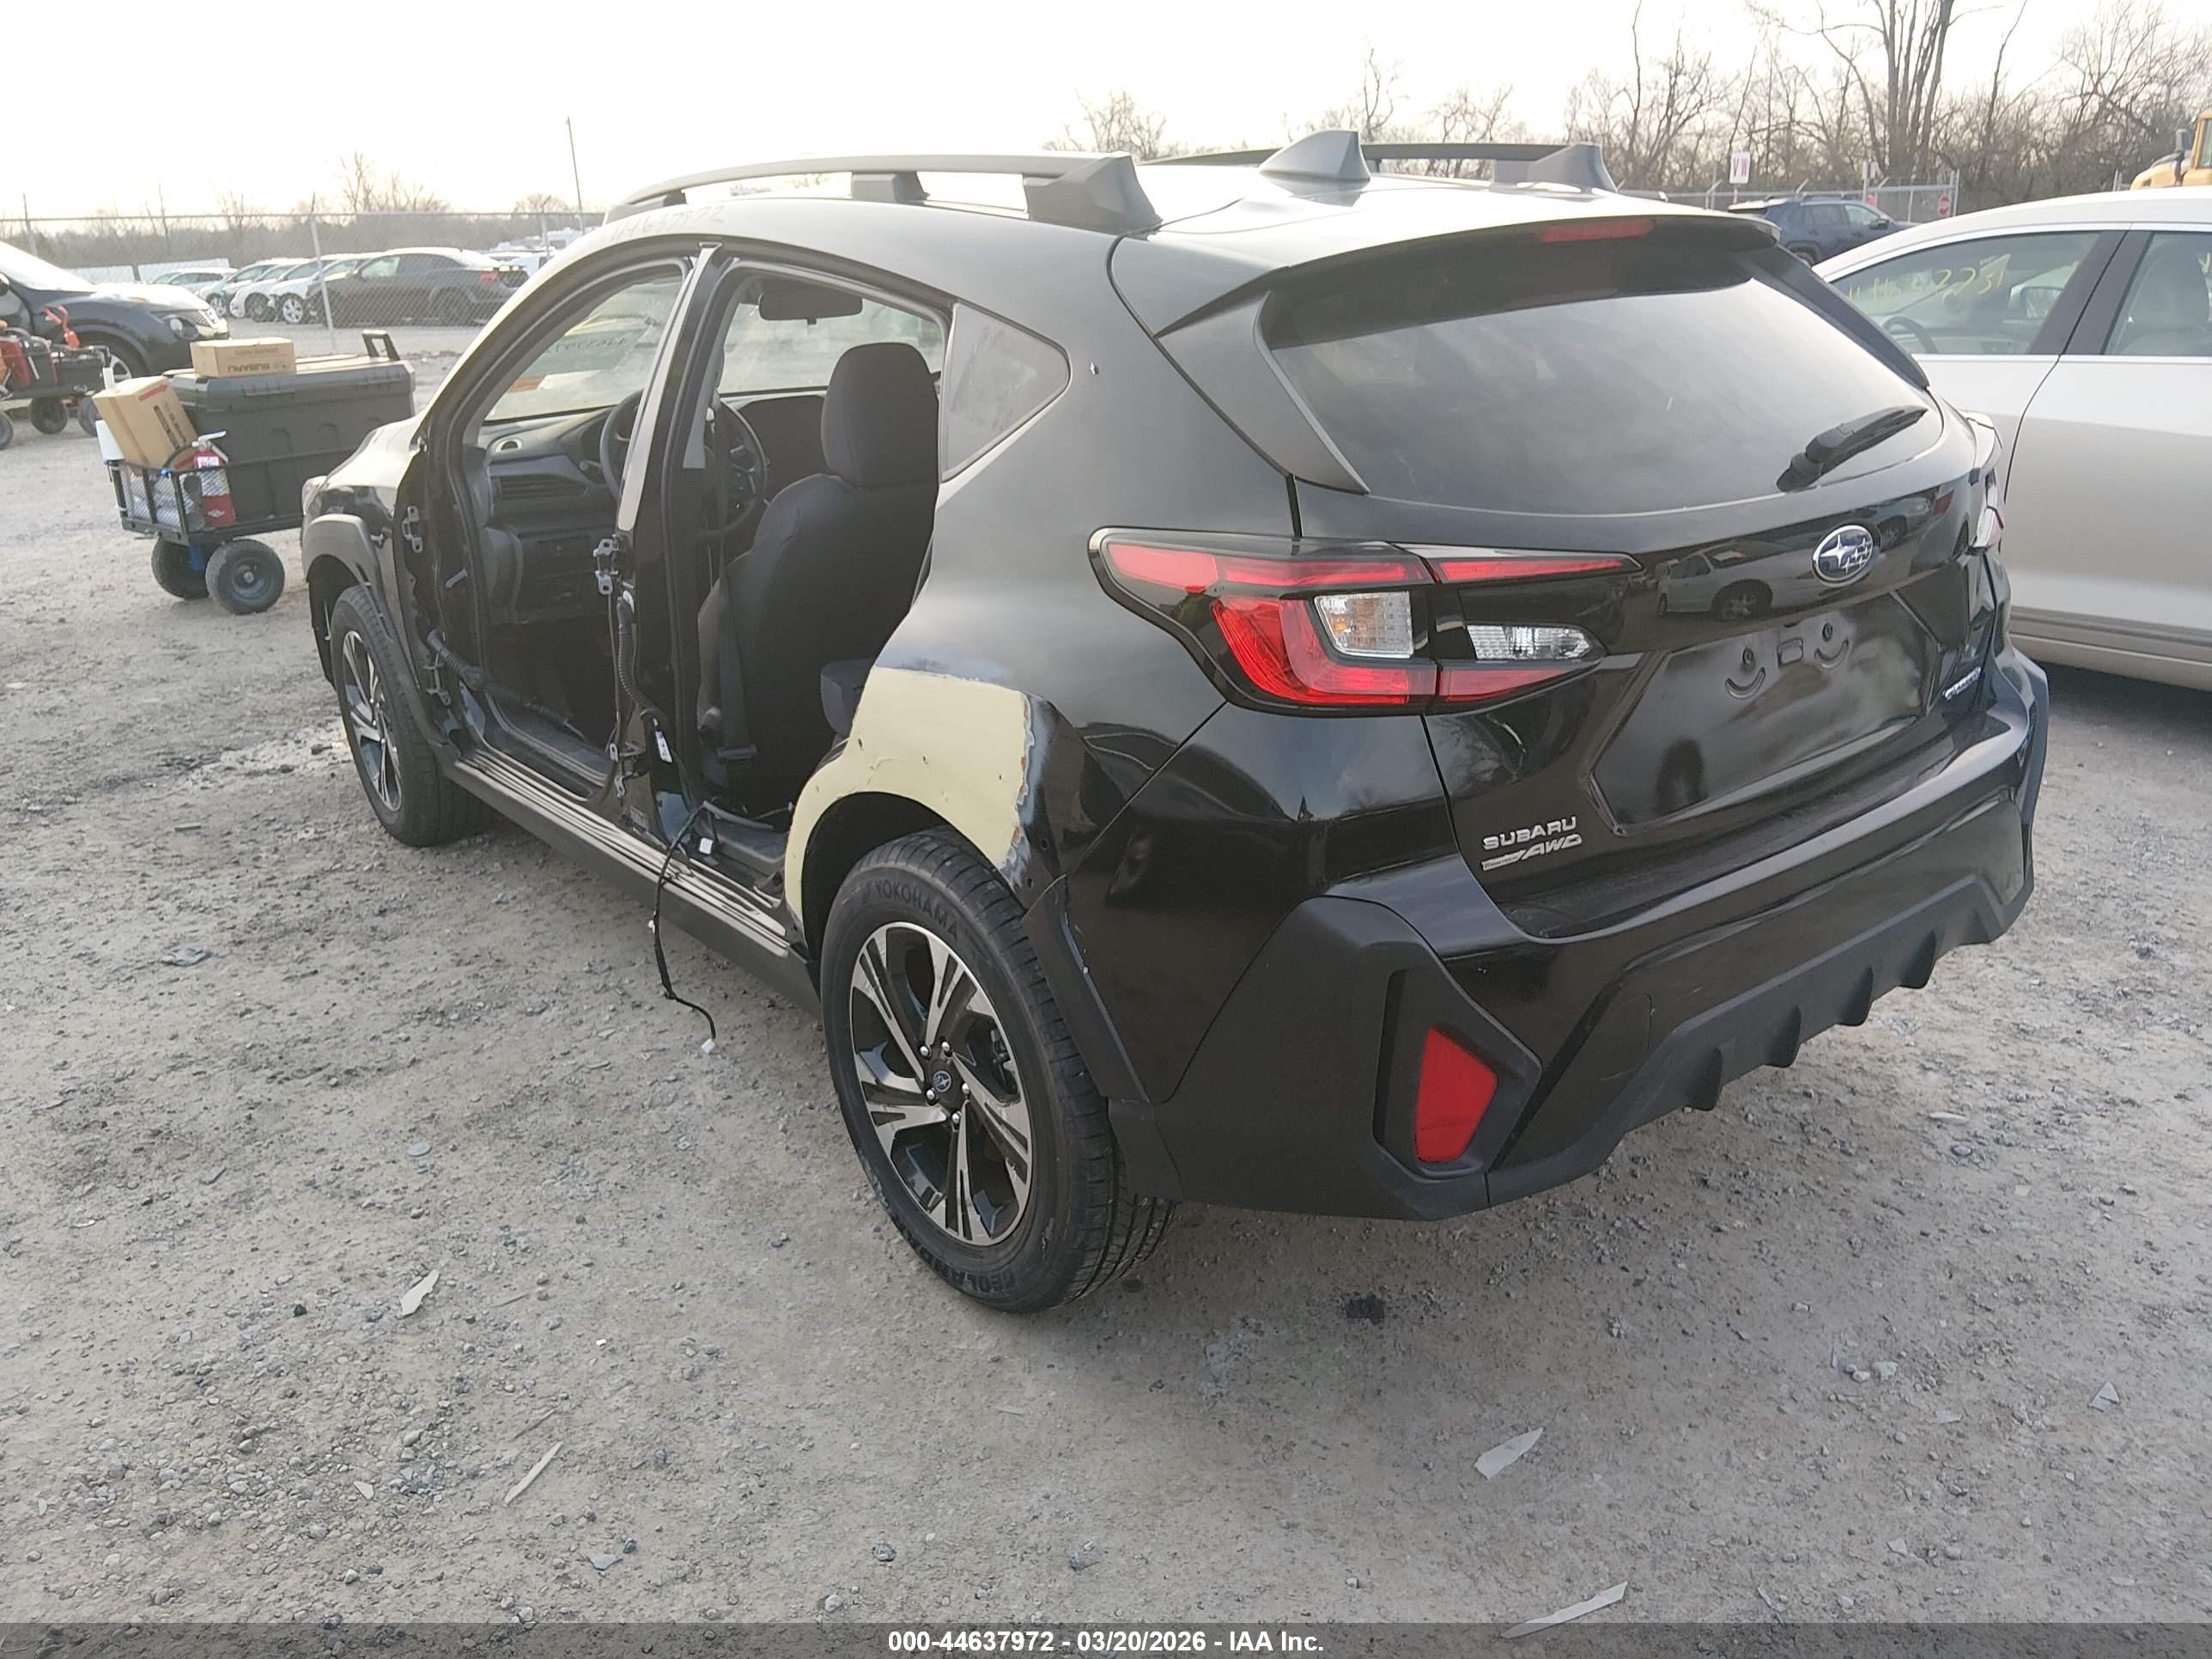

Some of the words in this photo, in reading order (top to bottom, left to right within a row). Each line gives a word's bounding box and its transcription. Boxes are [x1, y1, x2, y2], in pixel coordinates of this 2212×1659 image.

[1483, 816, 1577, 850] SUBARU
[1521, 833, 1583, 860] AWD
[875, 878, 958, 941] YOKOHAMA
